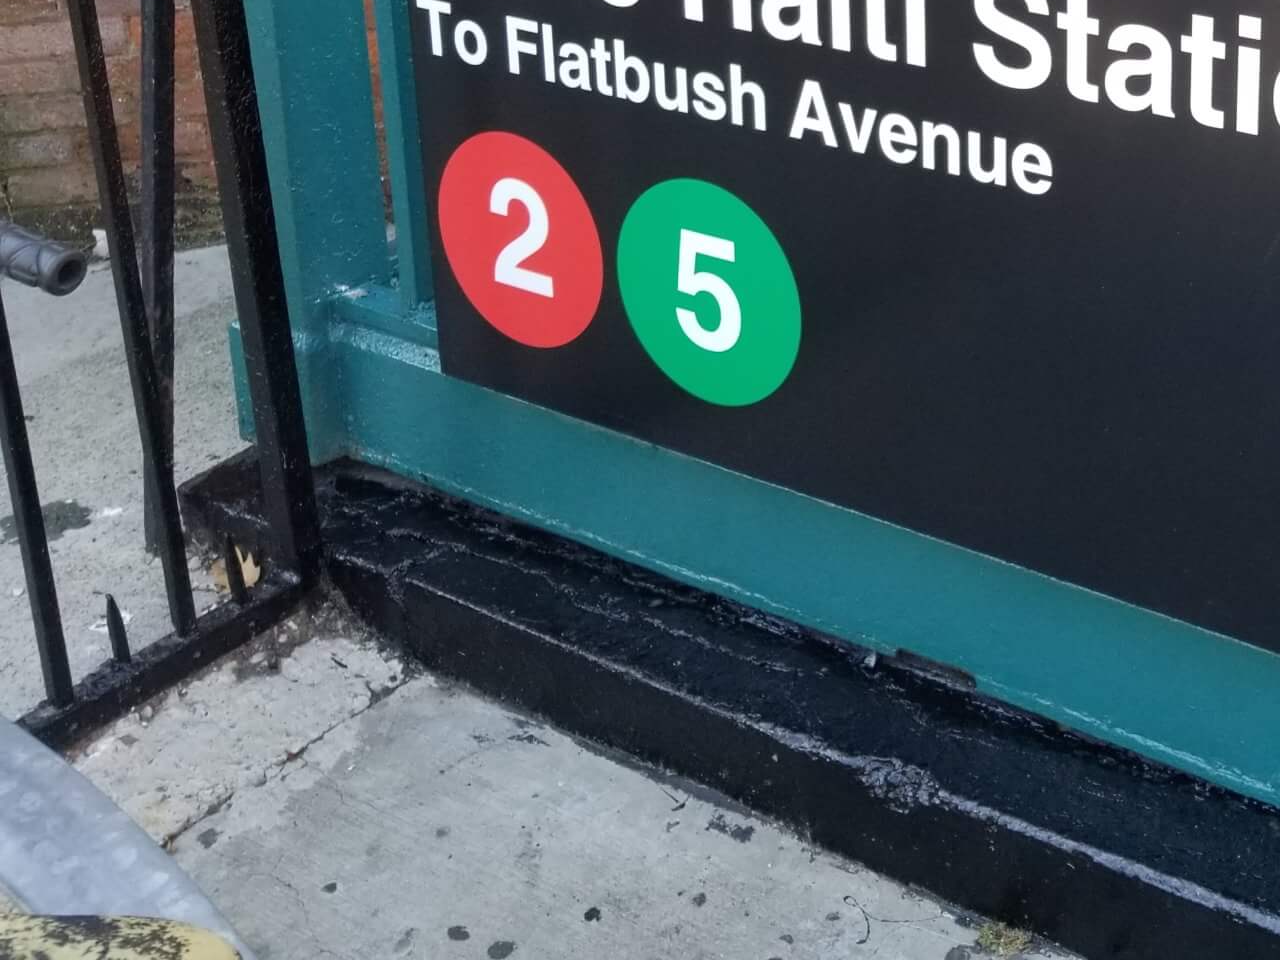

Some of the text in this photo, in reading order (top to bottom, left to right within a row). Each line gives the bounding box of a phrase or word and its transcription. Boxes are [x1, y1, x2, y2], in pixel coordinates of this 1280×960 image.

[506, 16, 766, 131] Flatbush
[790, 80, 1053, 195] Avenue
[489, 177, 742, 353] 2 5
